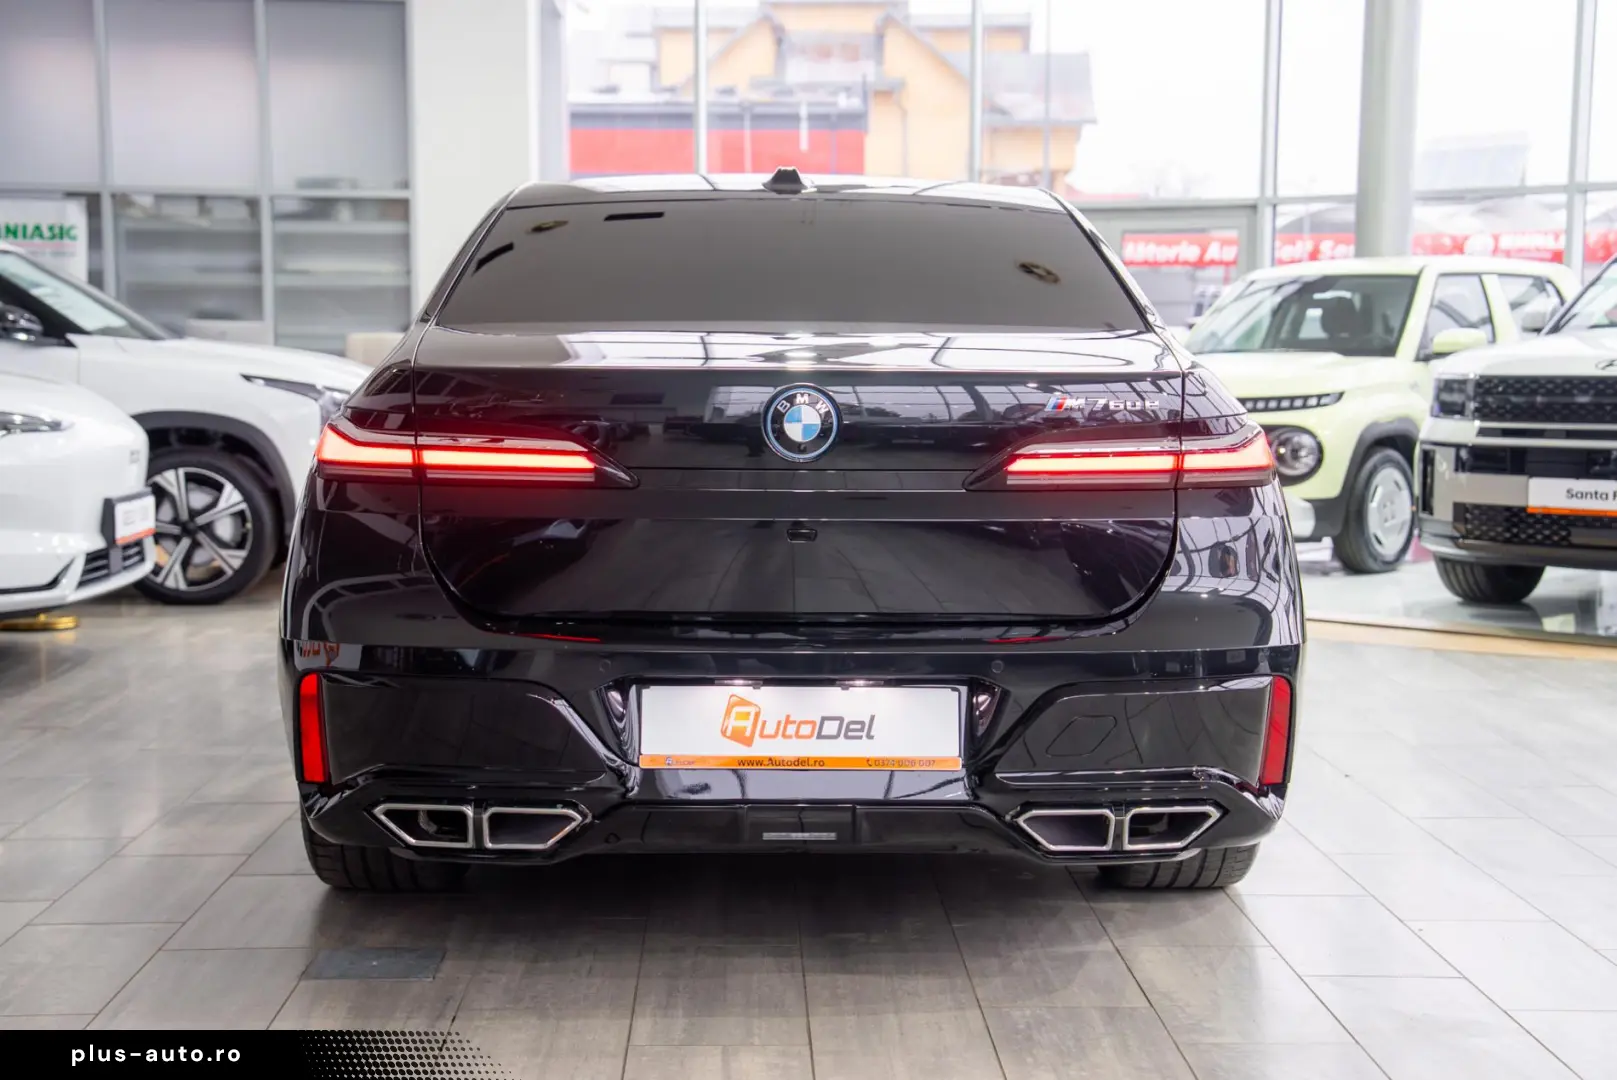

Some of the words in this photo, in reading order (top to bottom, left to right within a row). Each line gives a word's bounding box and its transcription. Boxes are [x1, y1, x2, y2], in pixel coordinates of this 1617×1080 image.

[777, 393, 829, 414] BMW
[1566, 488, 1609, 501] Santa
[722, 700, 876, 741] AutoDel
[737, 758, 825, 767] www.Autodel.ro
